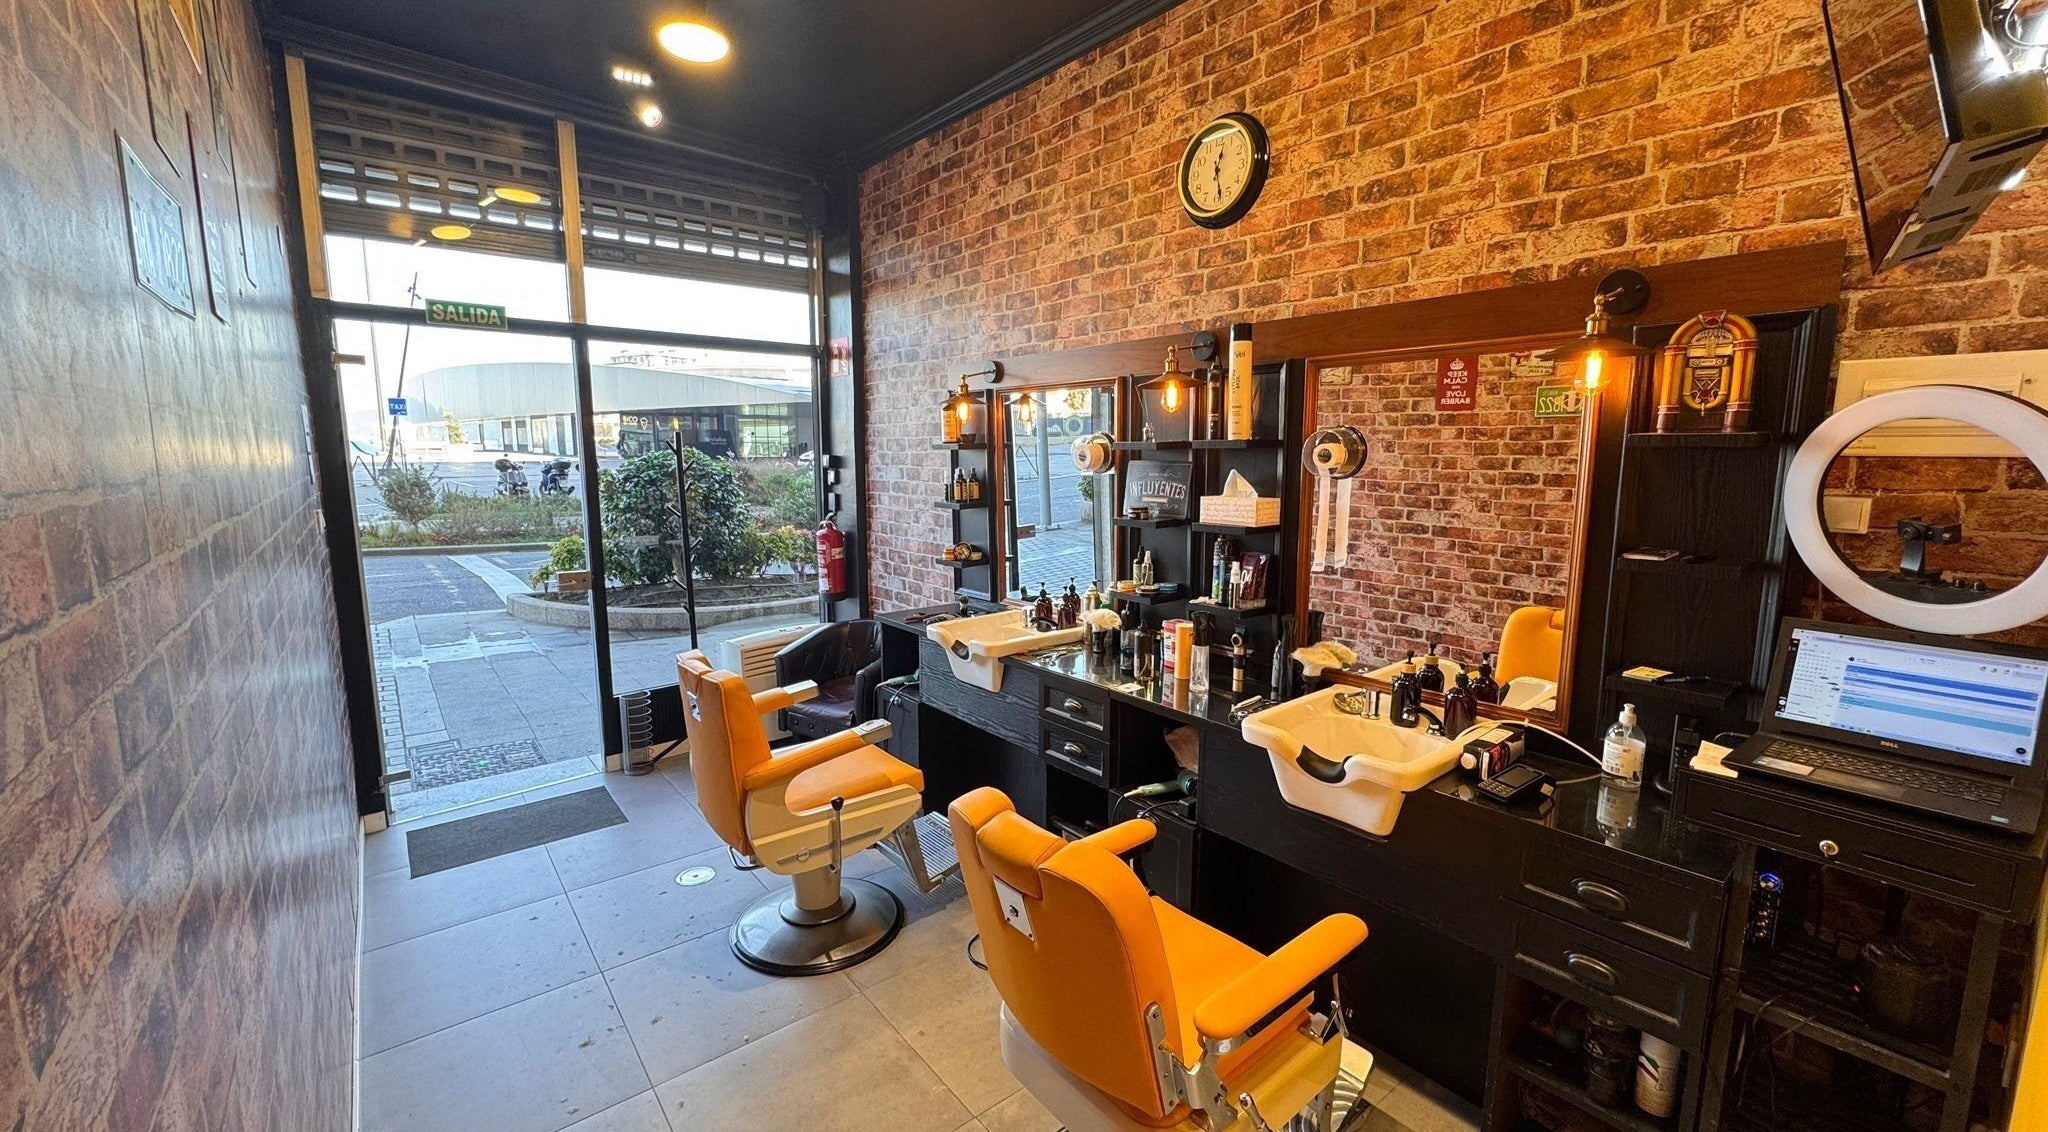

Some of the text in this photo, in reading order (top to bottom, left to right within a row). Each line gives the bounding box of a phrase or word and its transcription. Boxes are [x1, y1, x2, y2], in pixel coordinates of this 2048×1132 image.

[1236, 145, 1242, 155] 2
[1197, 157, 1206, 167] 10
[1239, 159, 1245, 169] 3
[1193, 171, 1199, 180] 9
[1234, 175, 1240, 184] 4
[1196, 184, 1201, 193] 8
[1225, 187, 1231, 197] 5
[1203, 192, 1208, 202] 7
[432, 303, 501, 325] SALIDA
[1129, 480, 1187, 499] INFLUYENTES
[1880, 740, 1899, 748] DELL
